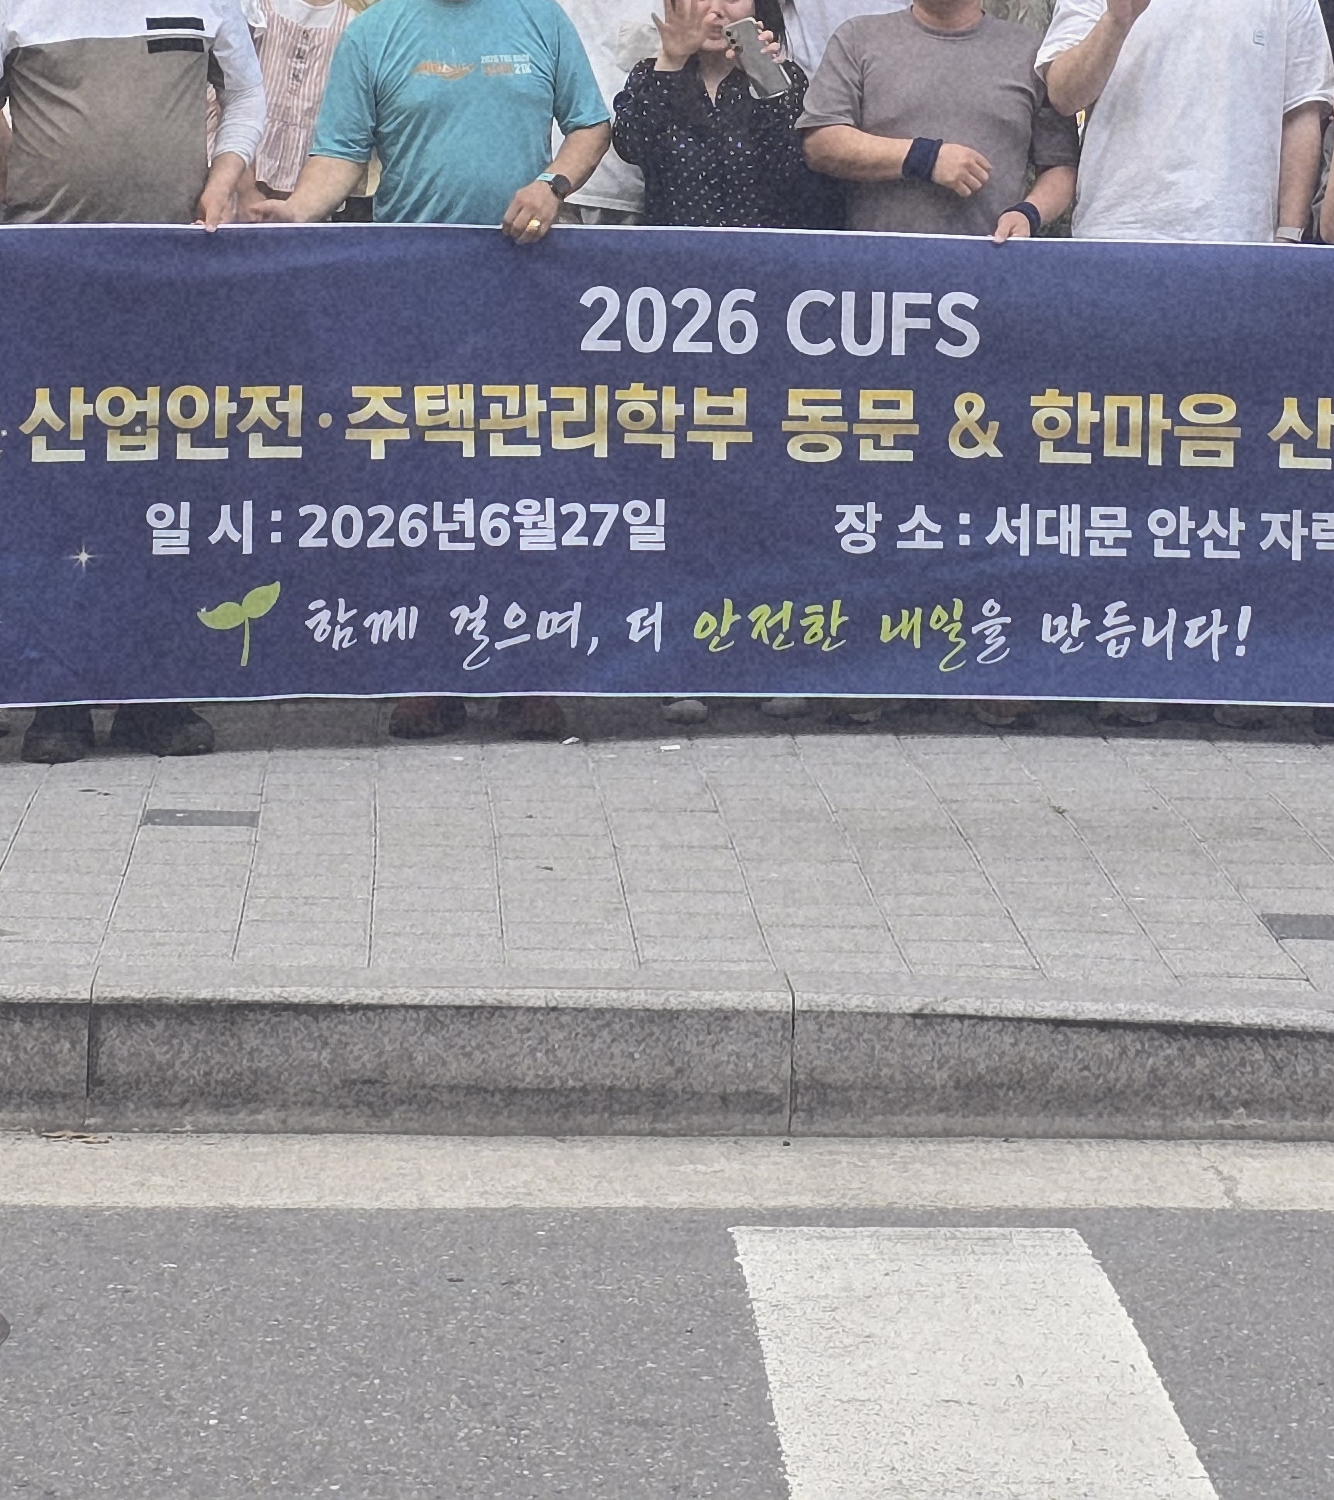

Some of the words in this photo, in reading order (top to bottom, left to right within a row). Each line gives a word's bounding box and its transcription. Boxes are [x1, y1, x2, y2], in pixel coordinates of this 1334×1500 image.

[579, 285, 759, 354] 2026
[786, 290, 980, 358] CUFS
[780, 389, 920, 463] 동문
[948, 392, 1004, 460] &
[1030, 389, 1242, 468] 한마음
[1147, 507, 1246, 560] 안산
[305, 598, 418, 650] 함께
[449, 594, 599, 670] 걸으며,
[626, 601, 663, 652] 더
[693, 597, 849, 652] 안전한
[880, 597, 1011, 672] 내일을
[1041, 599, 1253, 661] 만듭니다!
